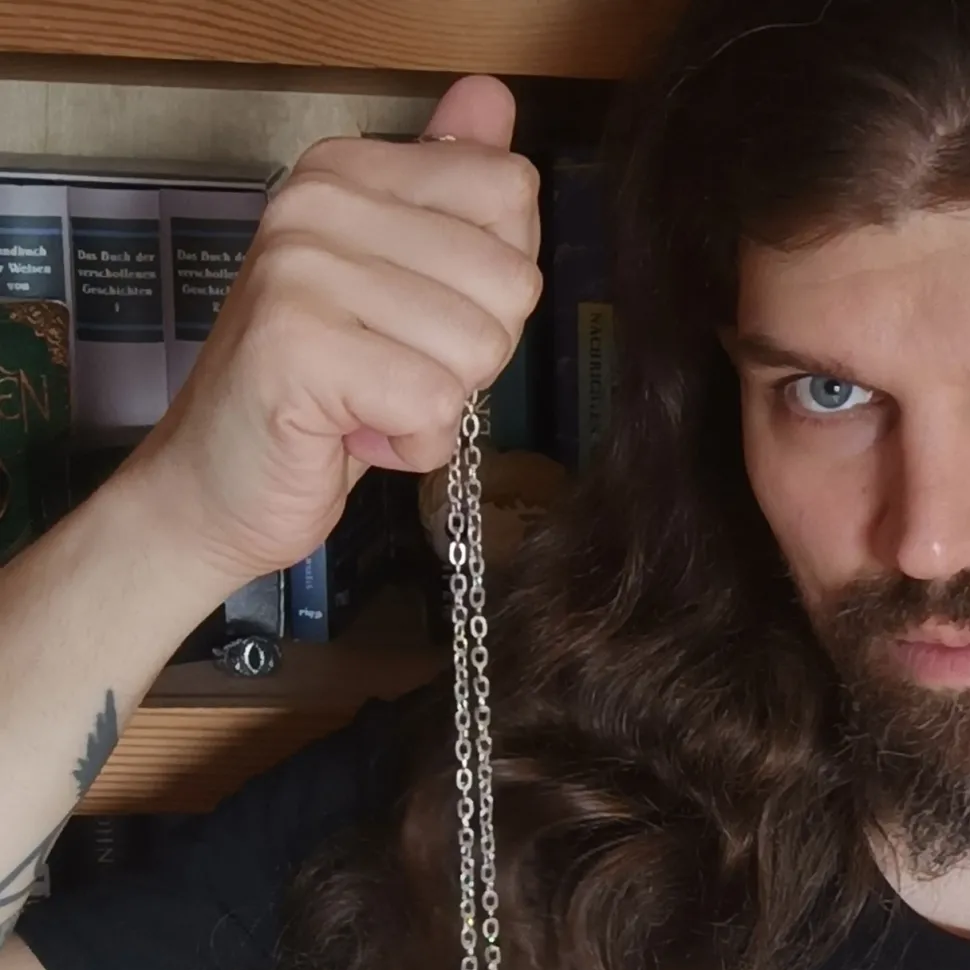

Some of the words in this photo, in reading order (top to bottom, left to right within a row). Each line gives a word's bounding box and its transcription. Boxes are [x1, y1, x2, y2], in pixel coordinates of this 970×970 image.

[77, 249, 98, 261] Das
[101, 250, 131, 262] Buch
[135, 250, 156, 263] der
